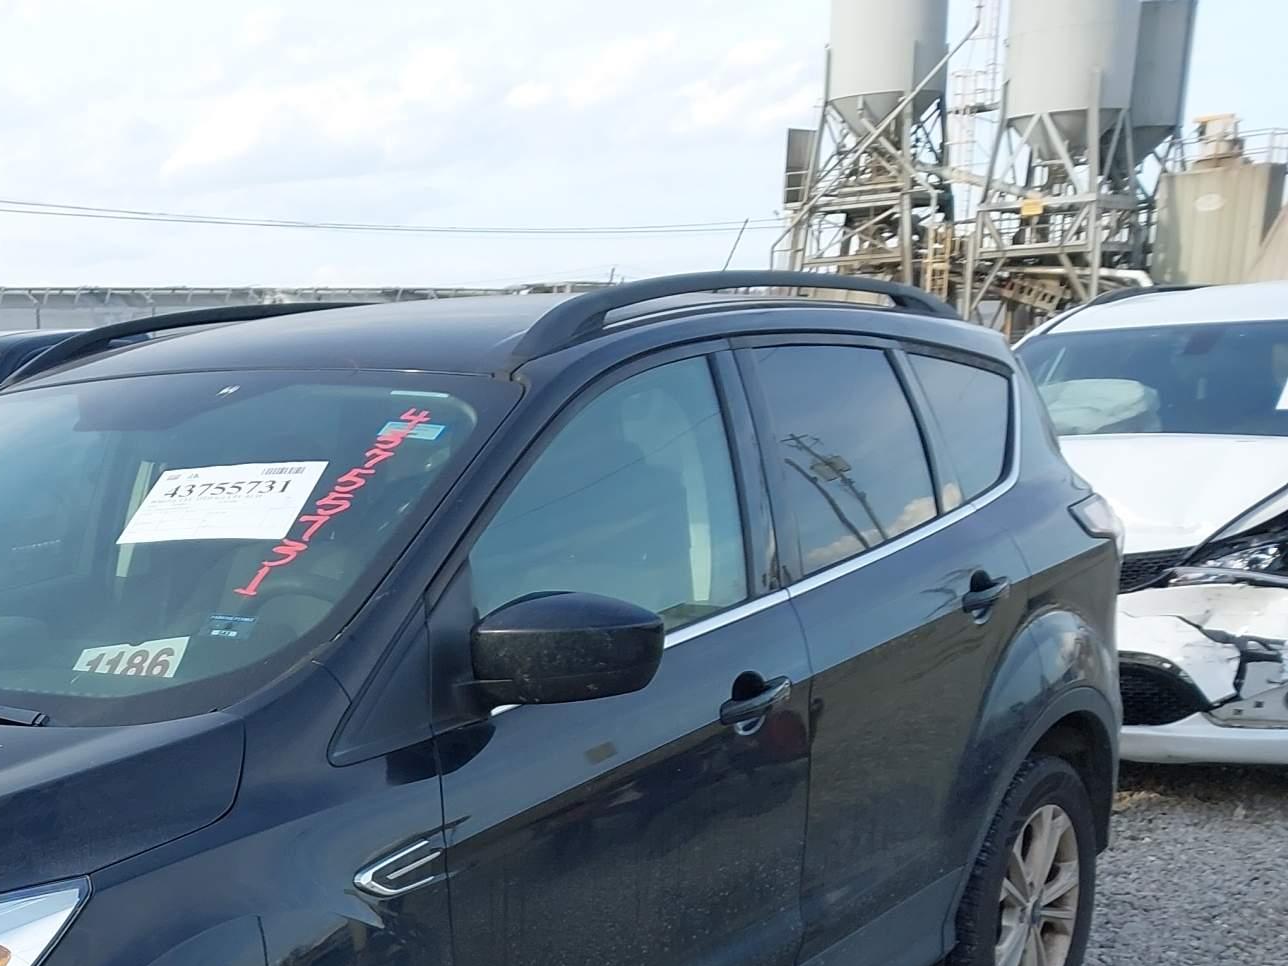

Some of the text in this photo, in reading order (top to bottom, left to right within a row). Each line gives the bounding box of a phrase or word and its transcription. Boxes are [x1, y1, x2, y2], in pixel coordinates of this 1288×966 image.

[163, 479, 292, 499] 43755731
[233, 408, 431, 596] 43755731
[85, 647, 175, 677] 1186
